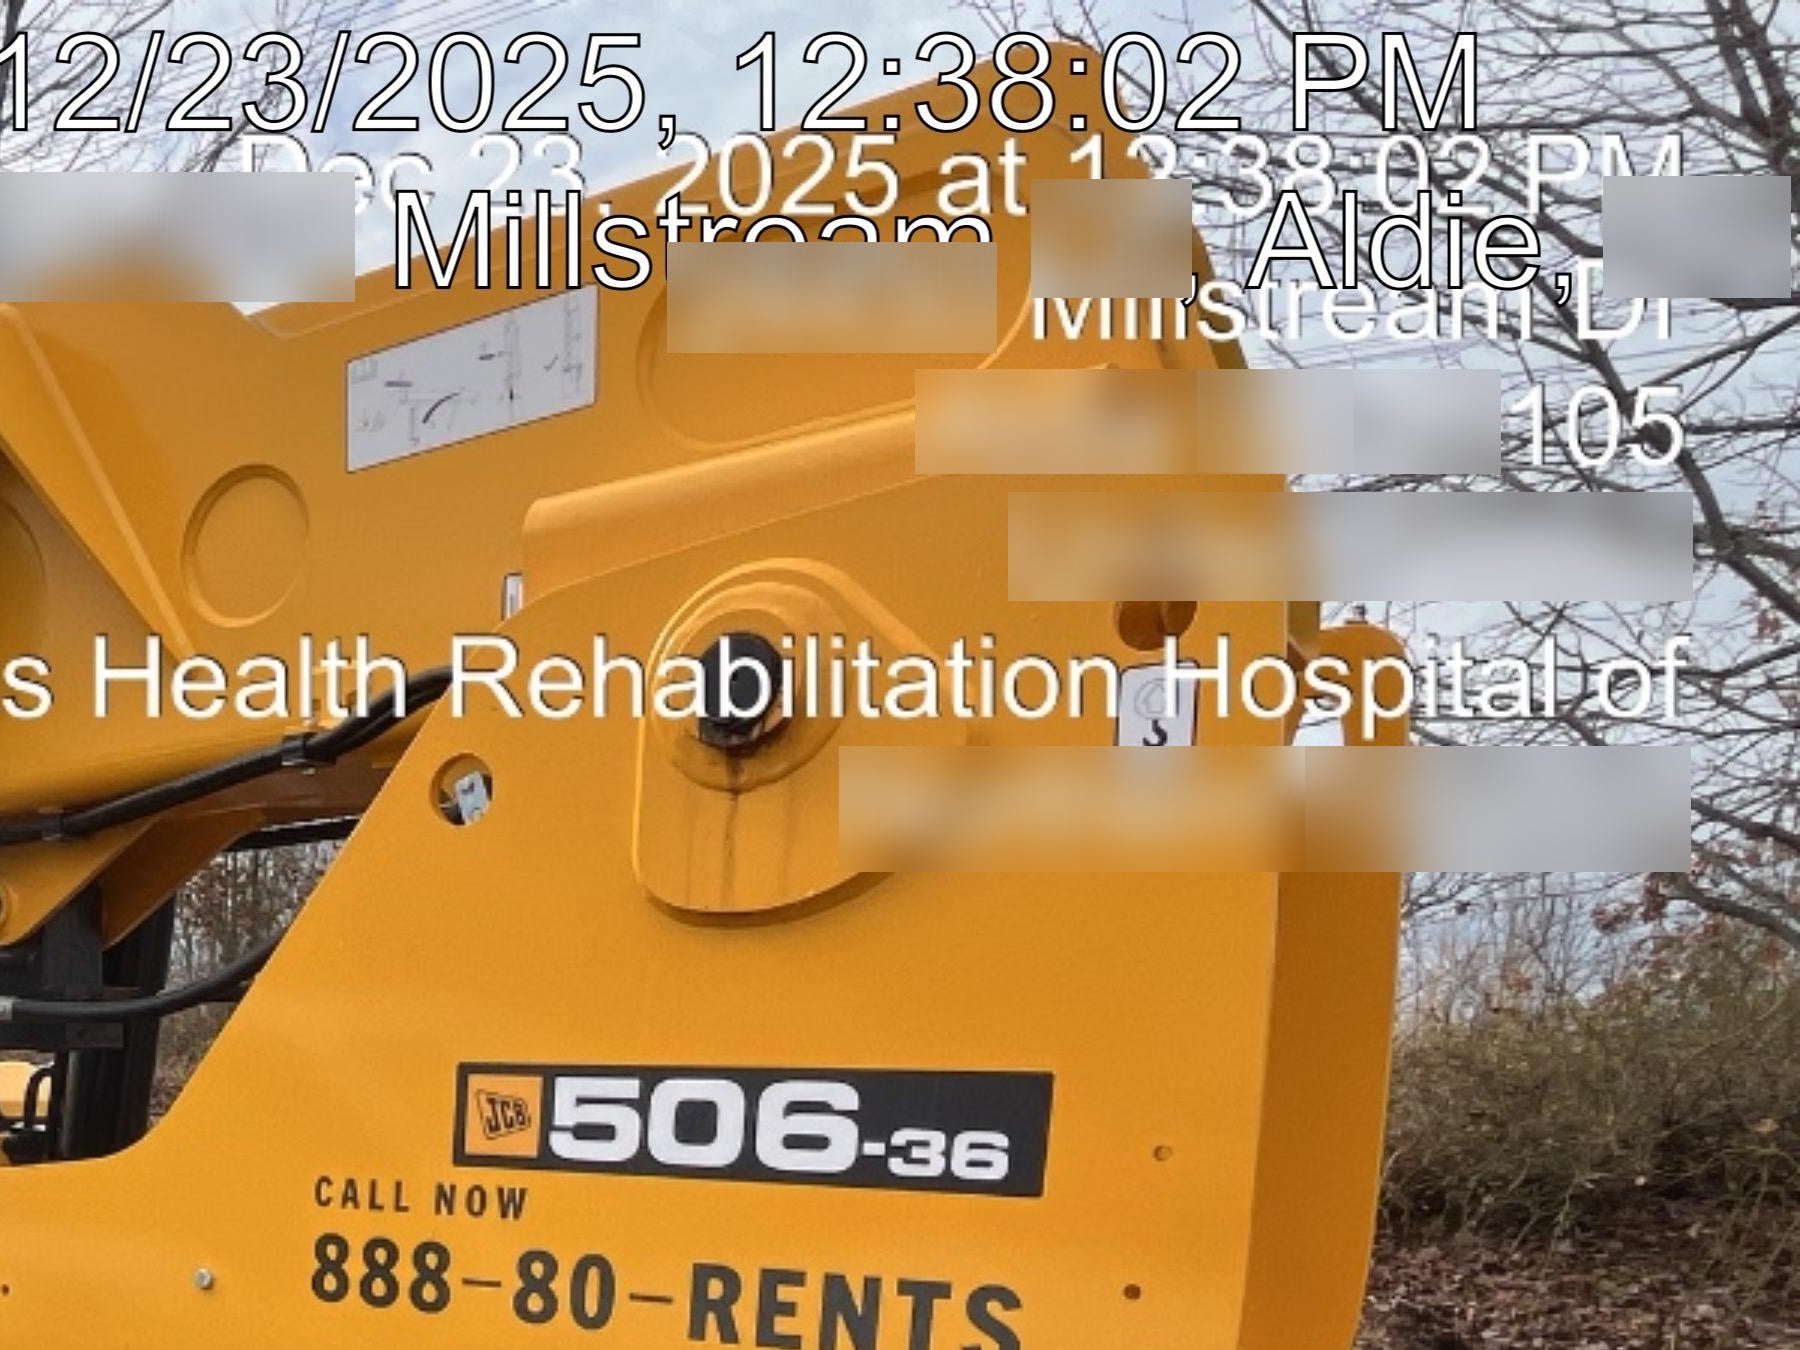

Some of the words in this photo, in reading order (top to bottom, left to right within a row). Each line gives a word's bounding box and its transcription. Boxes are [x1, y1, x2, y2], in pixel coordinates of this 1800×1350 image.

[481, 1093, 529, 1136] JCB
[547, 1074, 1011, 1181] 506-36
[314, 1175, 412, 1214] CALL
[433, 1181, 530, 1221] NOW
